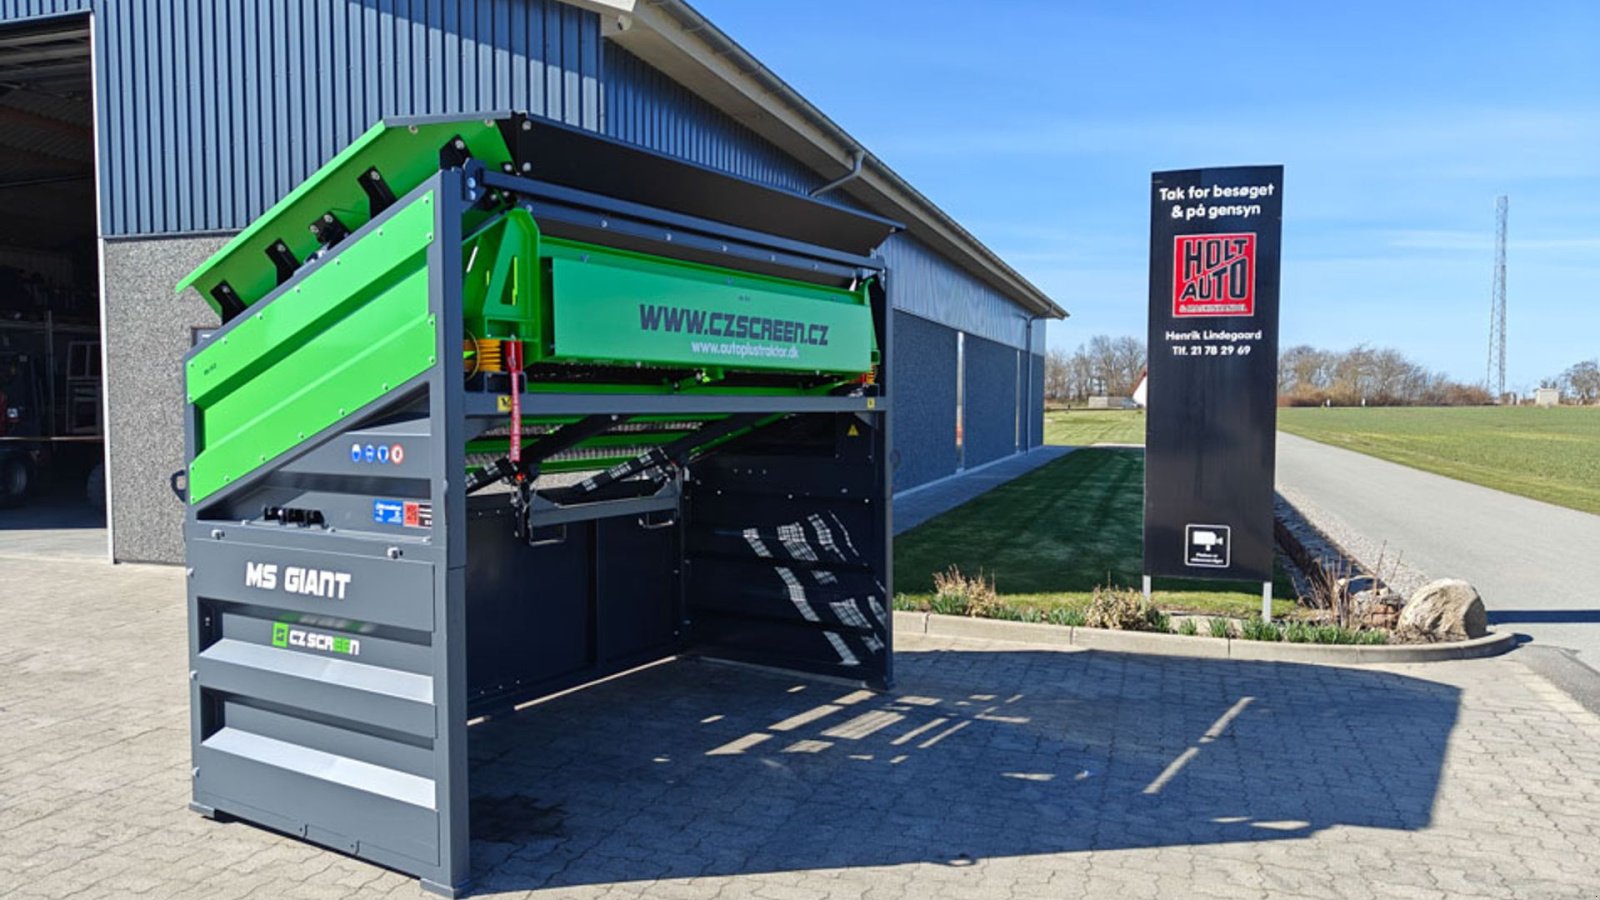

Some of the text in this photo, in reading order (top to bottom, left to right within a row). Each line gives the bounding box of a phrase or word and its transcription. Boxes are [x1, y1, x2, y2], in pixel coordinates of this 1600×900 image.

[1159, 183, 1275, 201] Tak for besøget
[1171, 203, 1261, 220] & på gensyn
[1183, 238, 1248, 281] HOLT
[1180, 256, 1248, 300] AUTO
[1165, 330, 1262, 342] Henrik Lindegaard
[1172, 345, 1251, 356] Tlf. 21 78 29 69
[246, 562, 351, 599] MS GIANT
